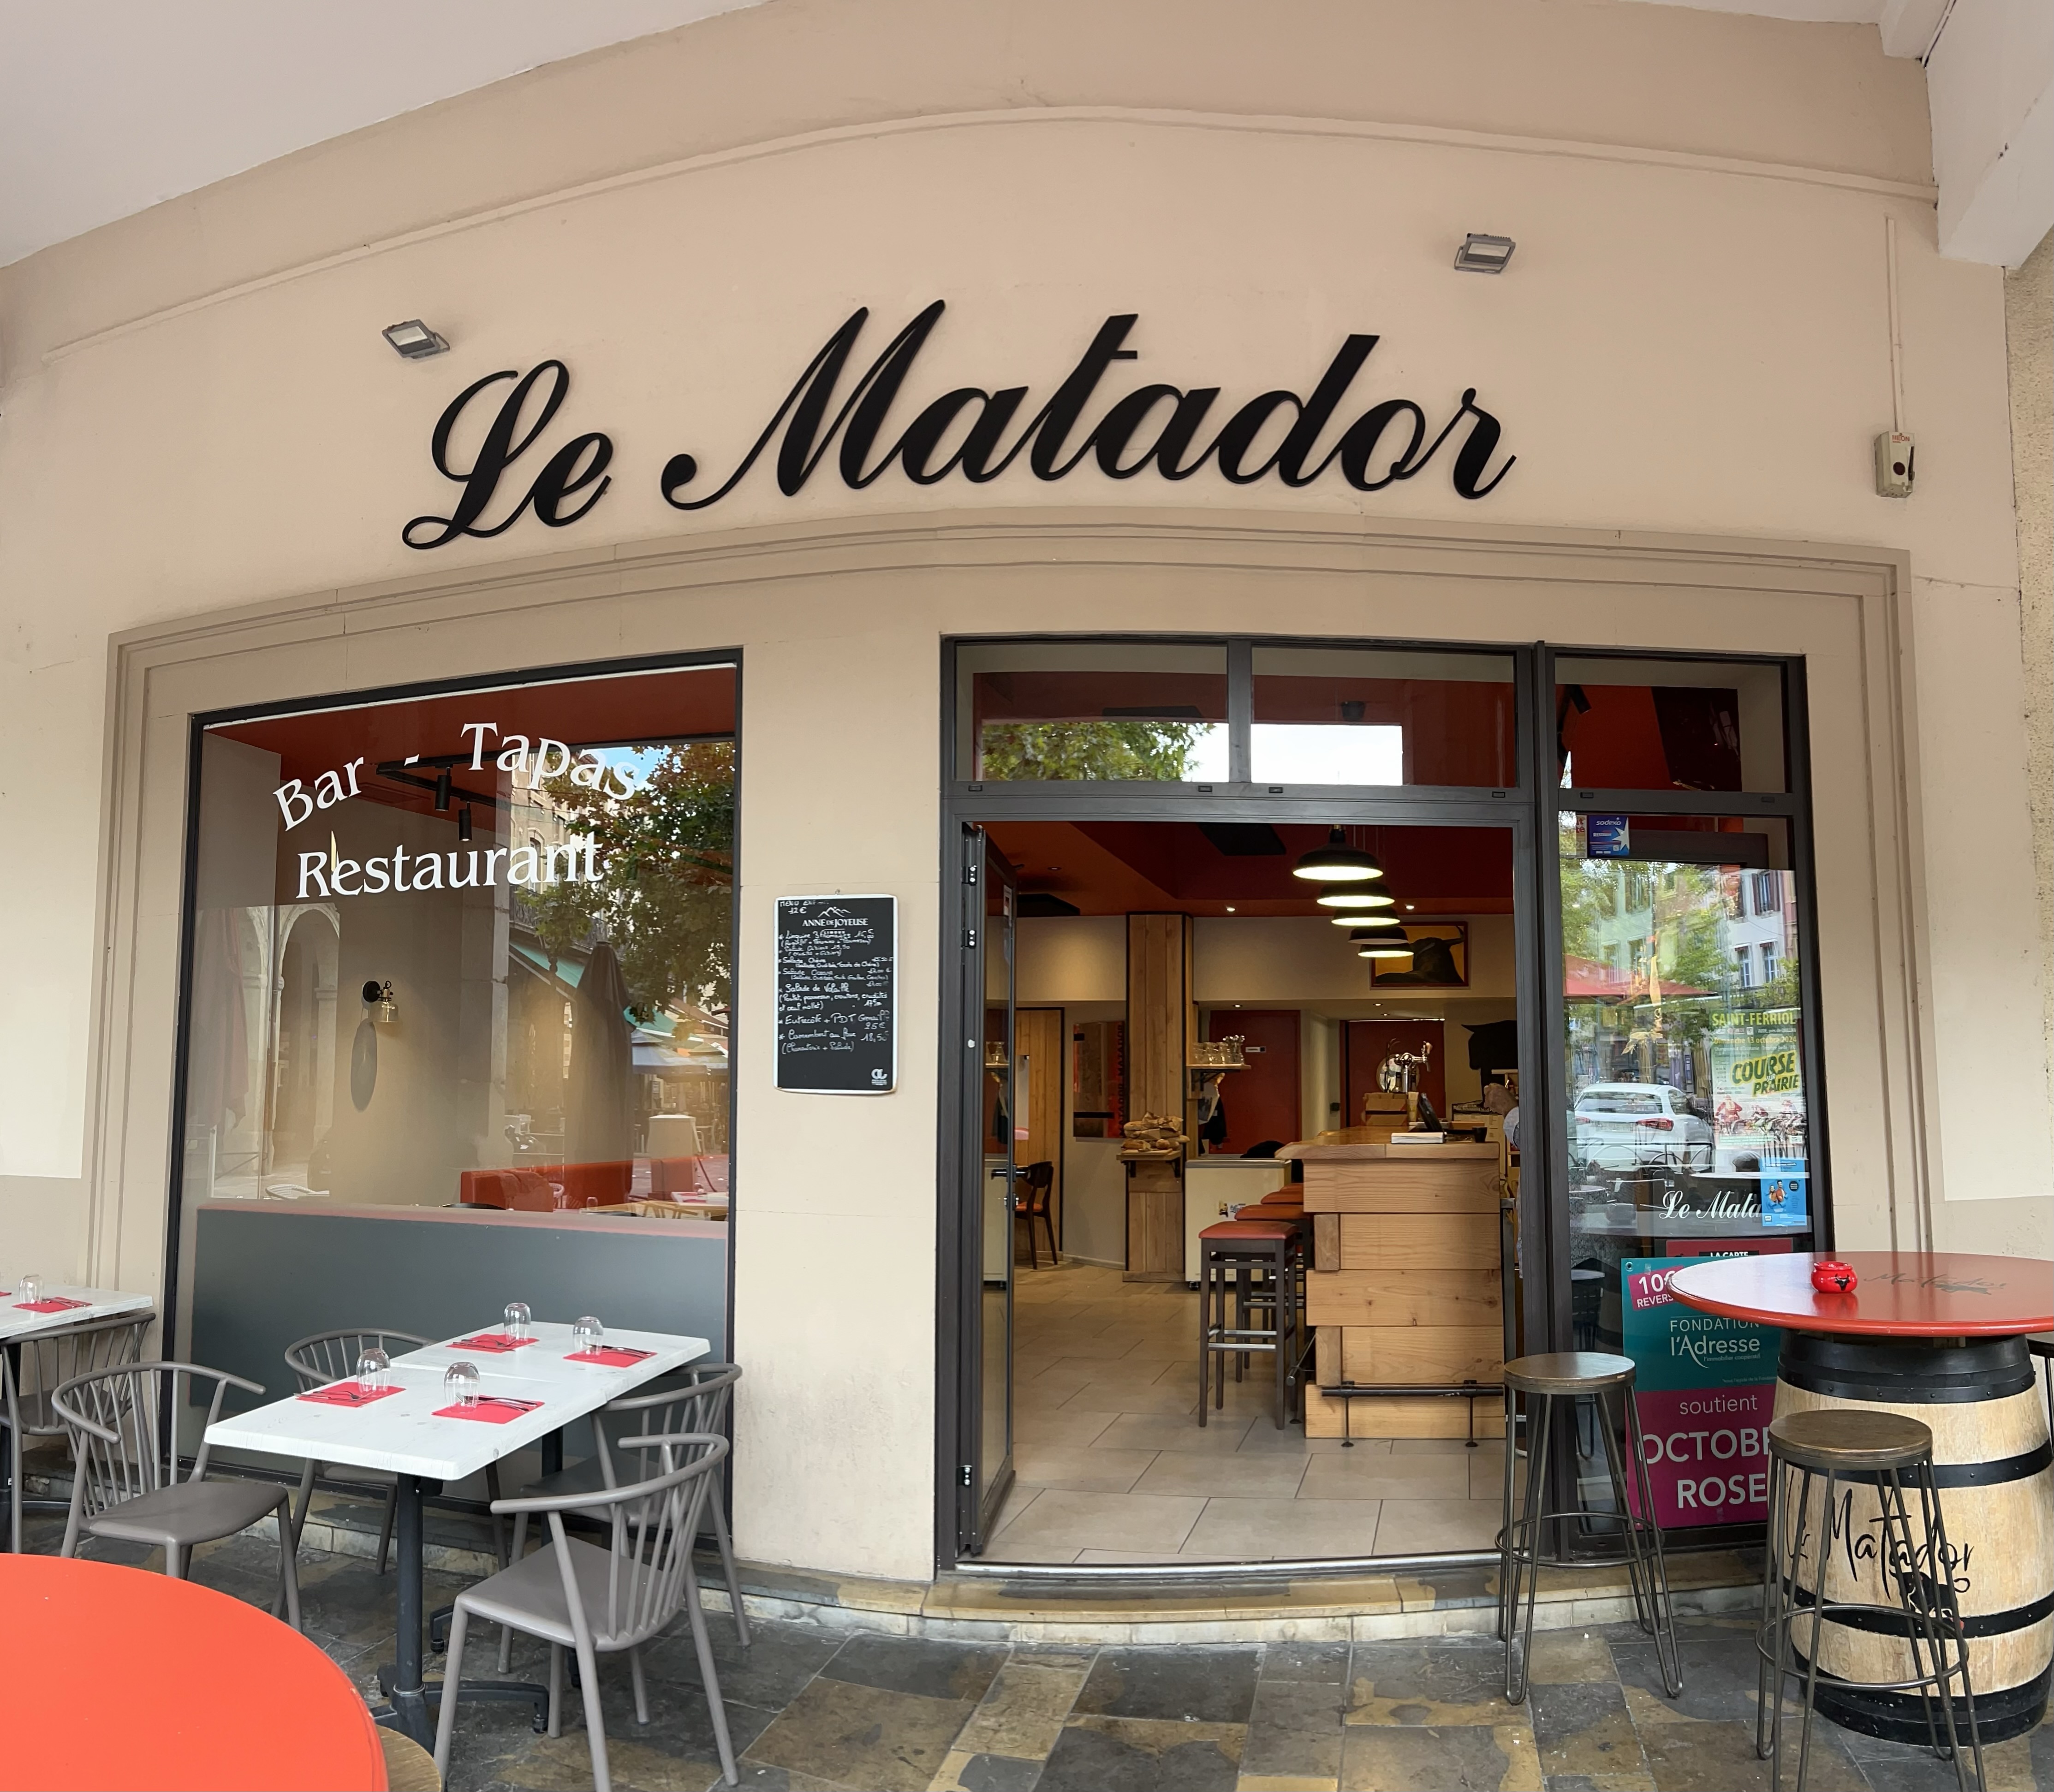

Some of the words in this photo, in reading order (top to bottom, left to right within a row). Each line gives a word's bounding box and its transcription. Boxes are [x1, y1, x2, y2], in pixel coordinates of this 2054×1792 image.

[402, 359, 614, 550] Le
[661, 299, 1517, 510] Matador
[273, 756, 365, 832] Bar
[461, 722, 640, 800] Tapas
[1596, 817, 1621, 826] sodexo
[296, 832, 604, 899] Restaurant
[1712, 1012, 1797, 1026] SAINT-FERRIOL
[1732, 1052, 1795, 1084] COURSE
[1753, 1074, 1799, 1097] PRAIRIE
[1659, 1191, 1690, 1219] Le
[1696, 1191, 1761, 1219] Mata
[1671, 1334, 1760, 1369] l'Adresse
[1679, 1394, 1758, 1416] soutient
[1678, 1473, 1767, 1509] ROSE
